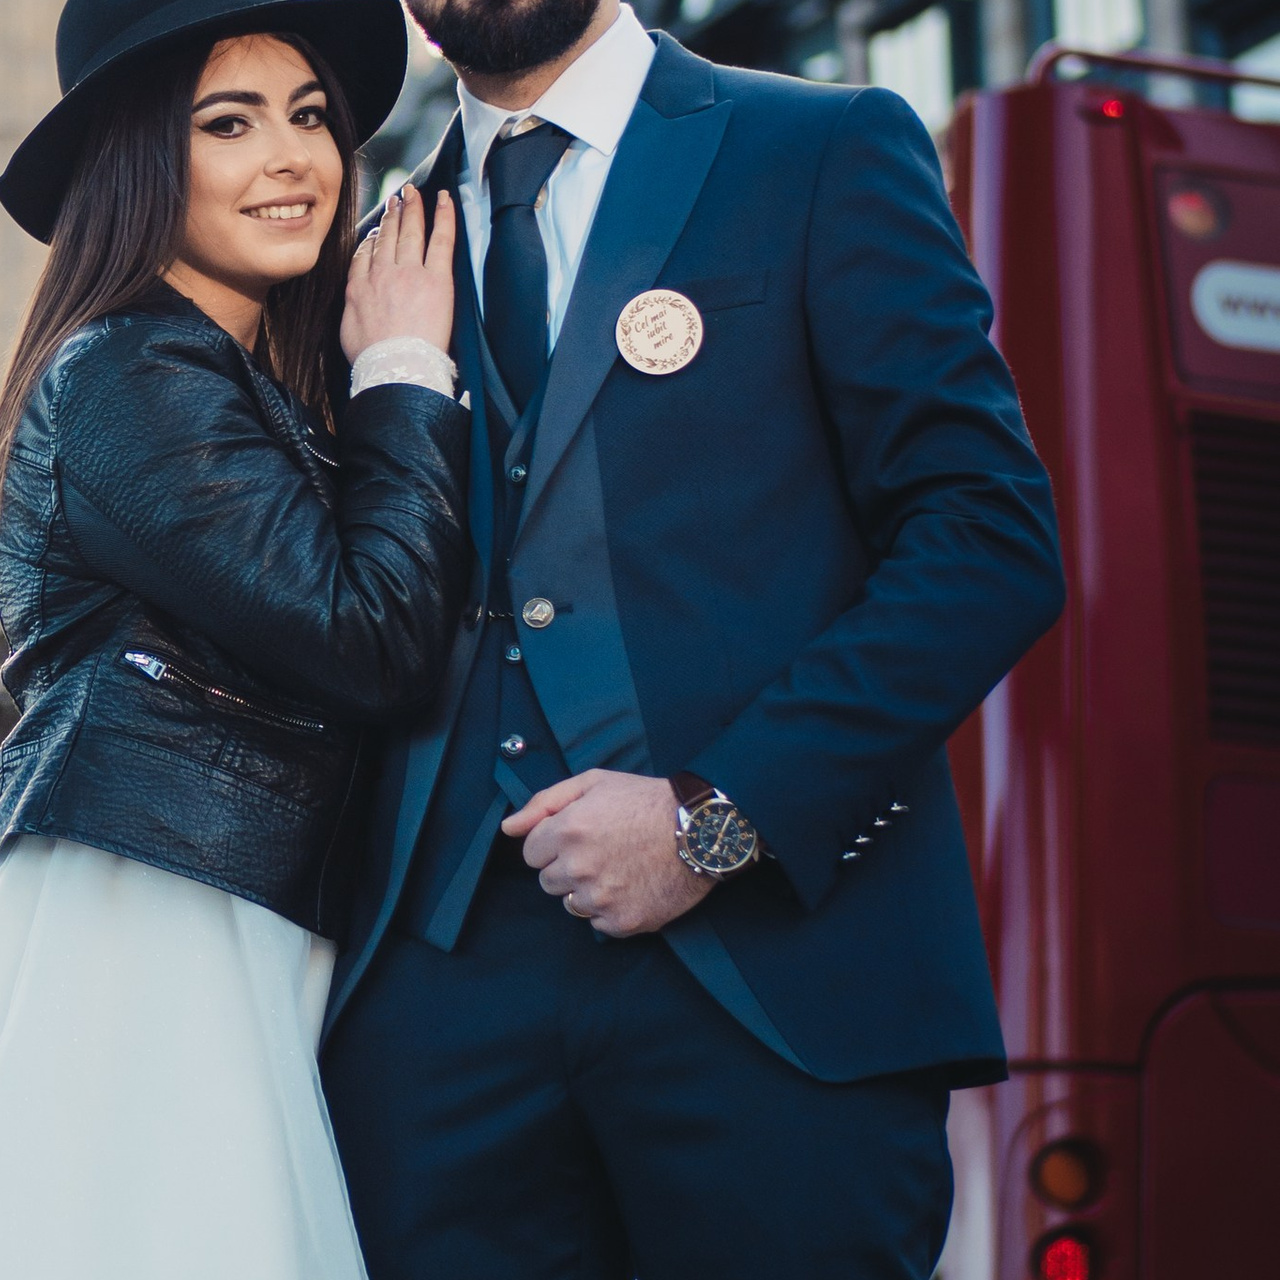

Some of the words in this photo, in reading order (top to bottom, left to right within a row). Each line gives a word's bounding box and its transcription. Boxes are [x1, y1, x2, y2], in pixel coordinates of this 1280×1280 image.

[635, 316, 648, 333] Cel
[651, 306, 667, 323] mai
[647, 321, 667, 339] iubit
[654, 333, 673, 349] mire
